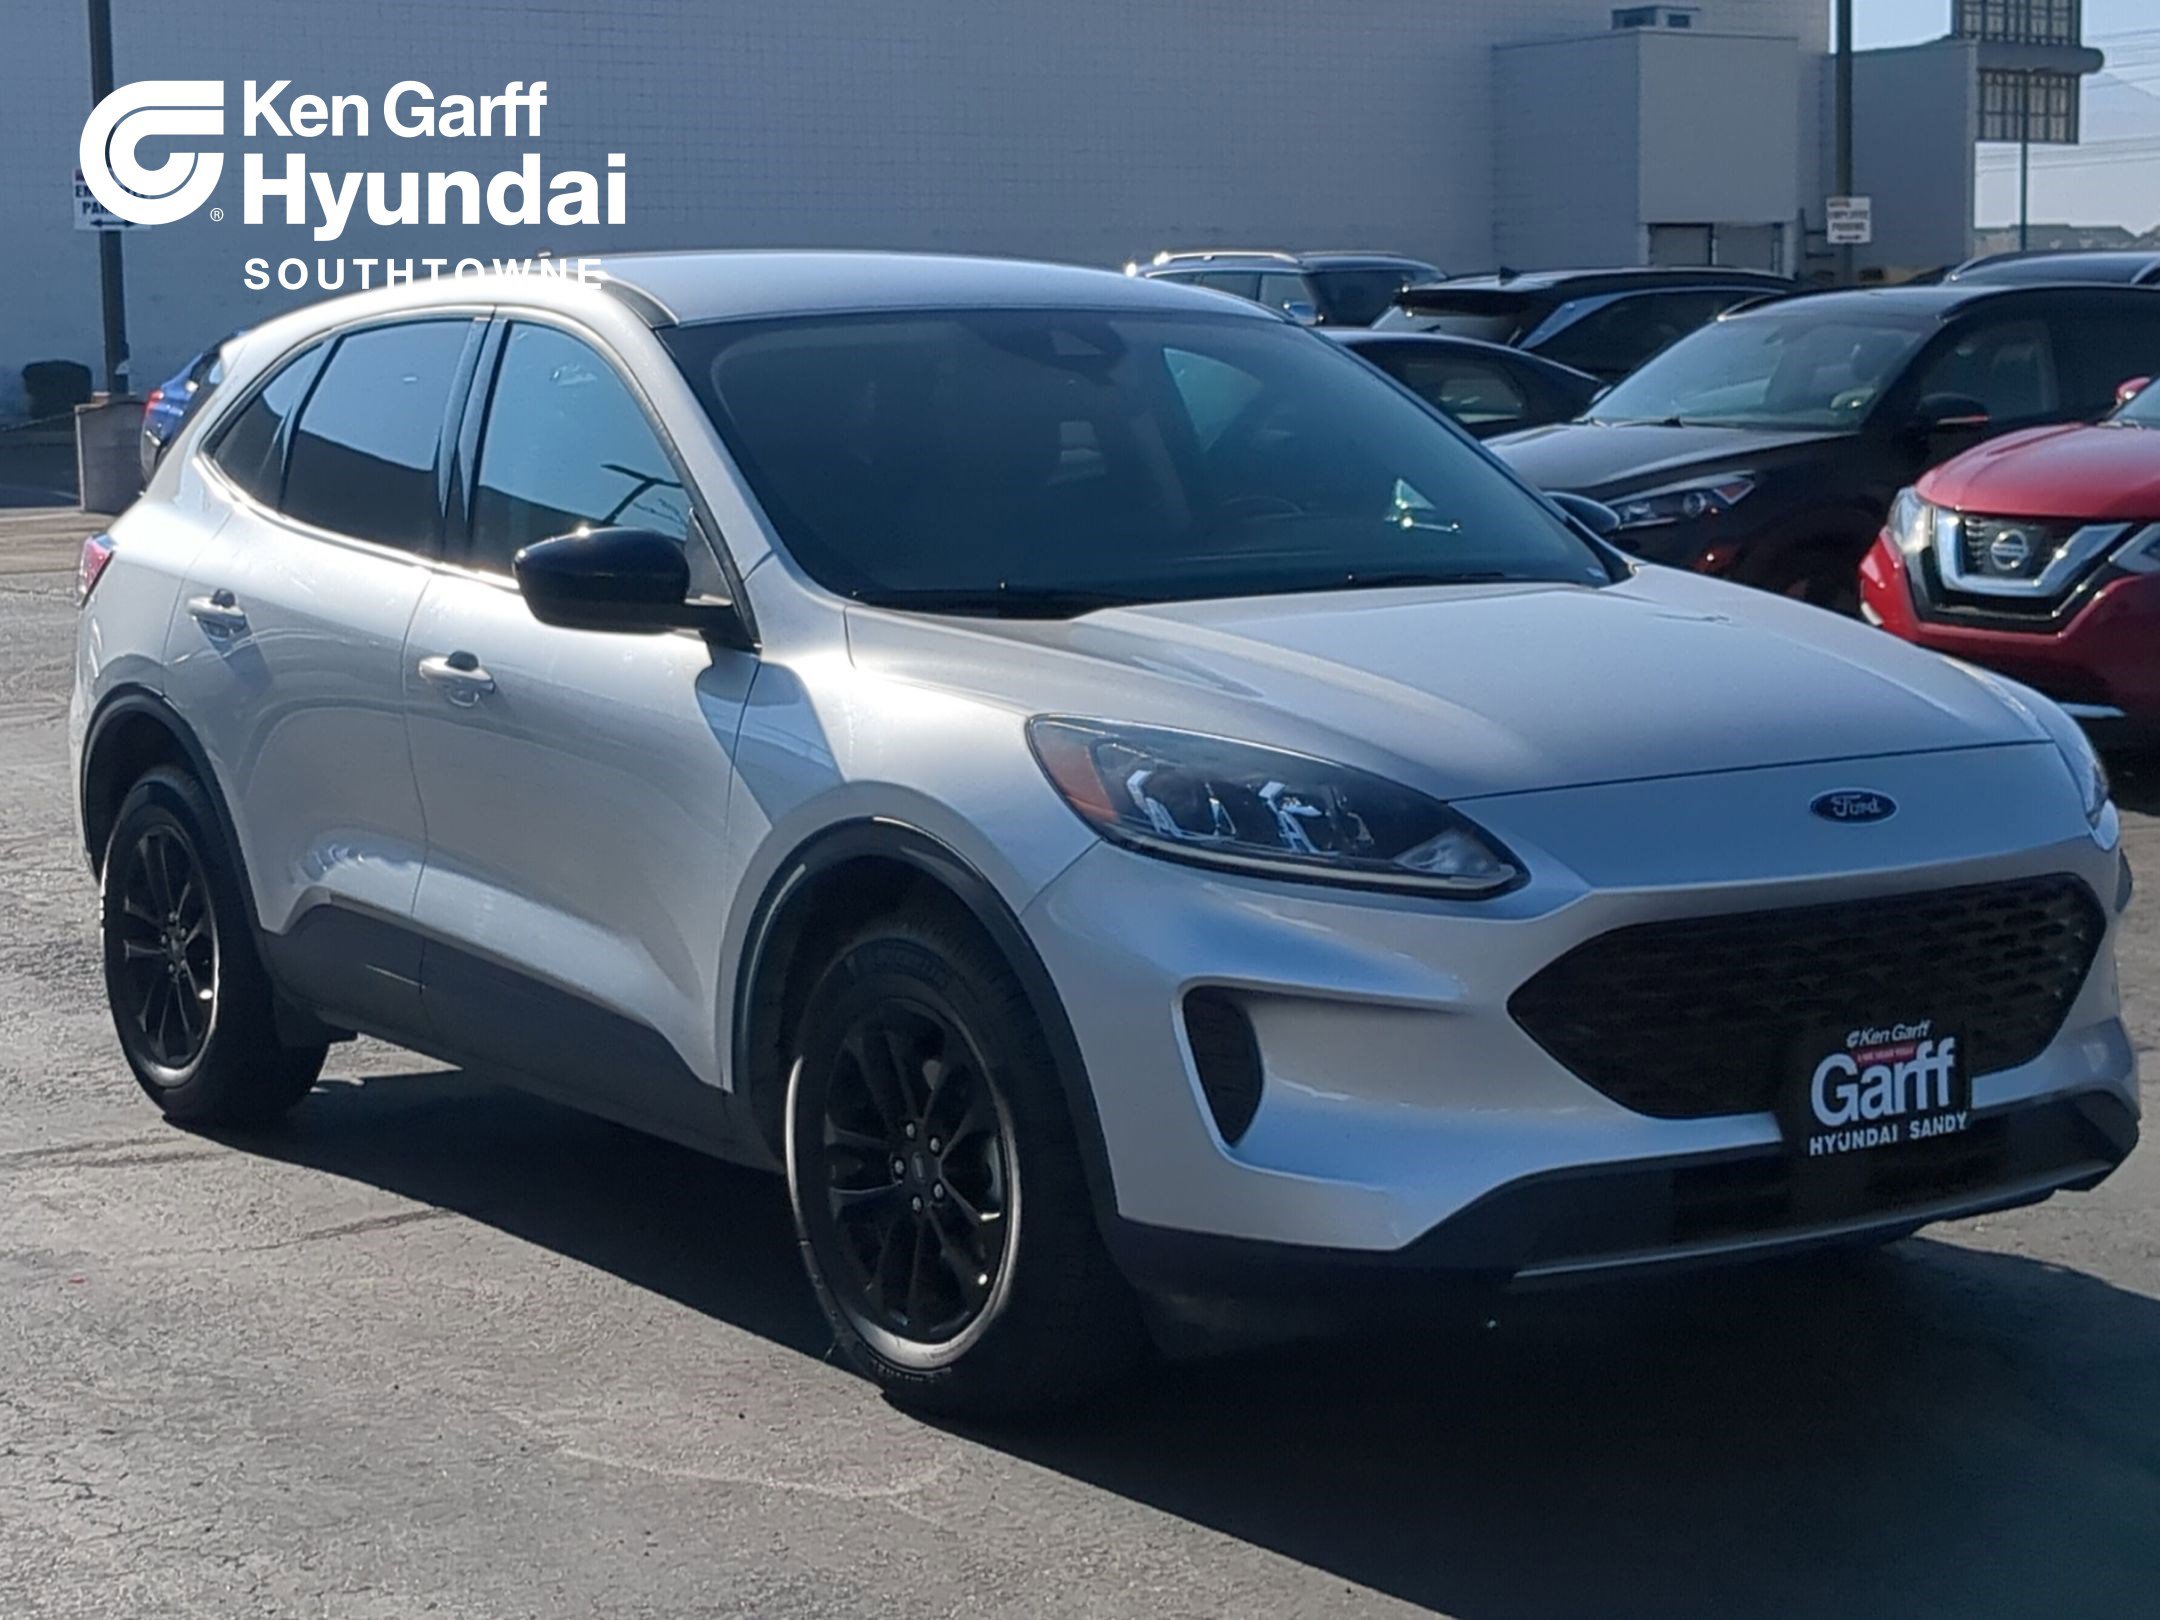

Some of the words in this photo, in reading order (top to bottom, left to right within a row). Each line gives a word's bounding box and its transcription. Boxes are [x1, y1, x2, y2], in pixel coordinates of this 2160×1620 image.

[1830, 794, 1882, 817] Ford
[1859, 1027, 1890, 1046] Ken
[1892, 1020, 1931, 1041] Garff
[1811, 1037, 1955, 1127] Garff
[1809, 1124, 1898, 1156] HYUNDAI
[1909, 1111, 1968, 1140] SANDY
